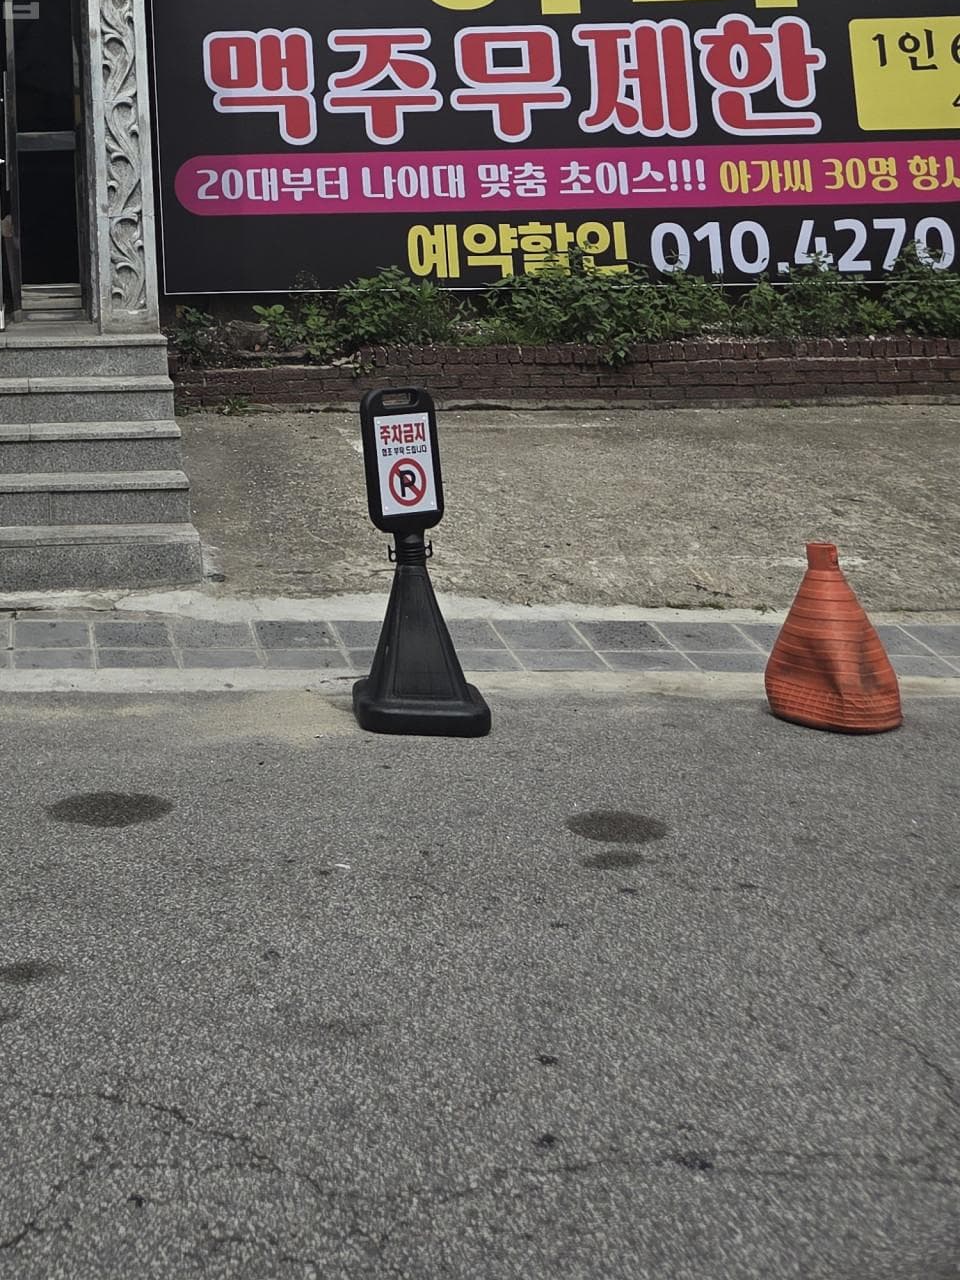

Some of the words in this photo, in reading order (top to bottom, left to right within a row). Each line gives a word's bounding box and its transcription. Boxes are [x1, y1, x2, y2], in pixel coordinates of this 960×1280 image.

[203, 13, 825, 145] 맥주무제한
[196, 167, 348, 201] 20대부터
[361, 164, 466, 200] 나이대
[477, 162, 548, 198] 맞춤
[559, 158, 706, 195] 초이스!!!
[720, 158, 813, 194] 아가씨
[823, 156, 898, 192] 30명
[407, 221, 630, 279] 예약할인
[380, 422, 426, 445] 주차금지
